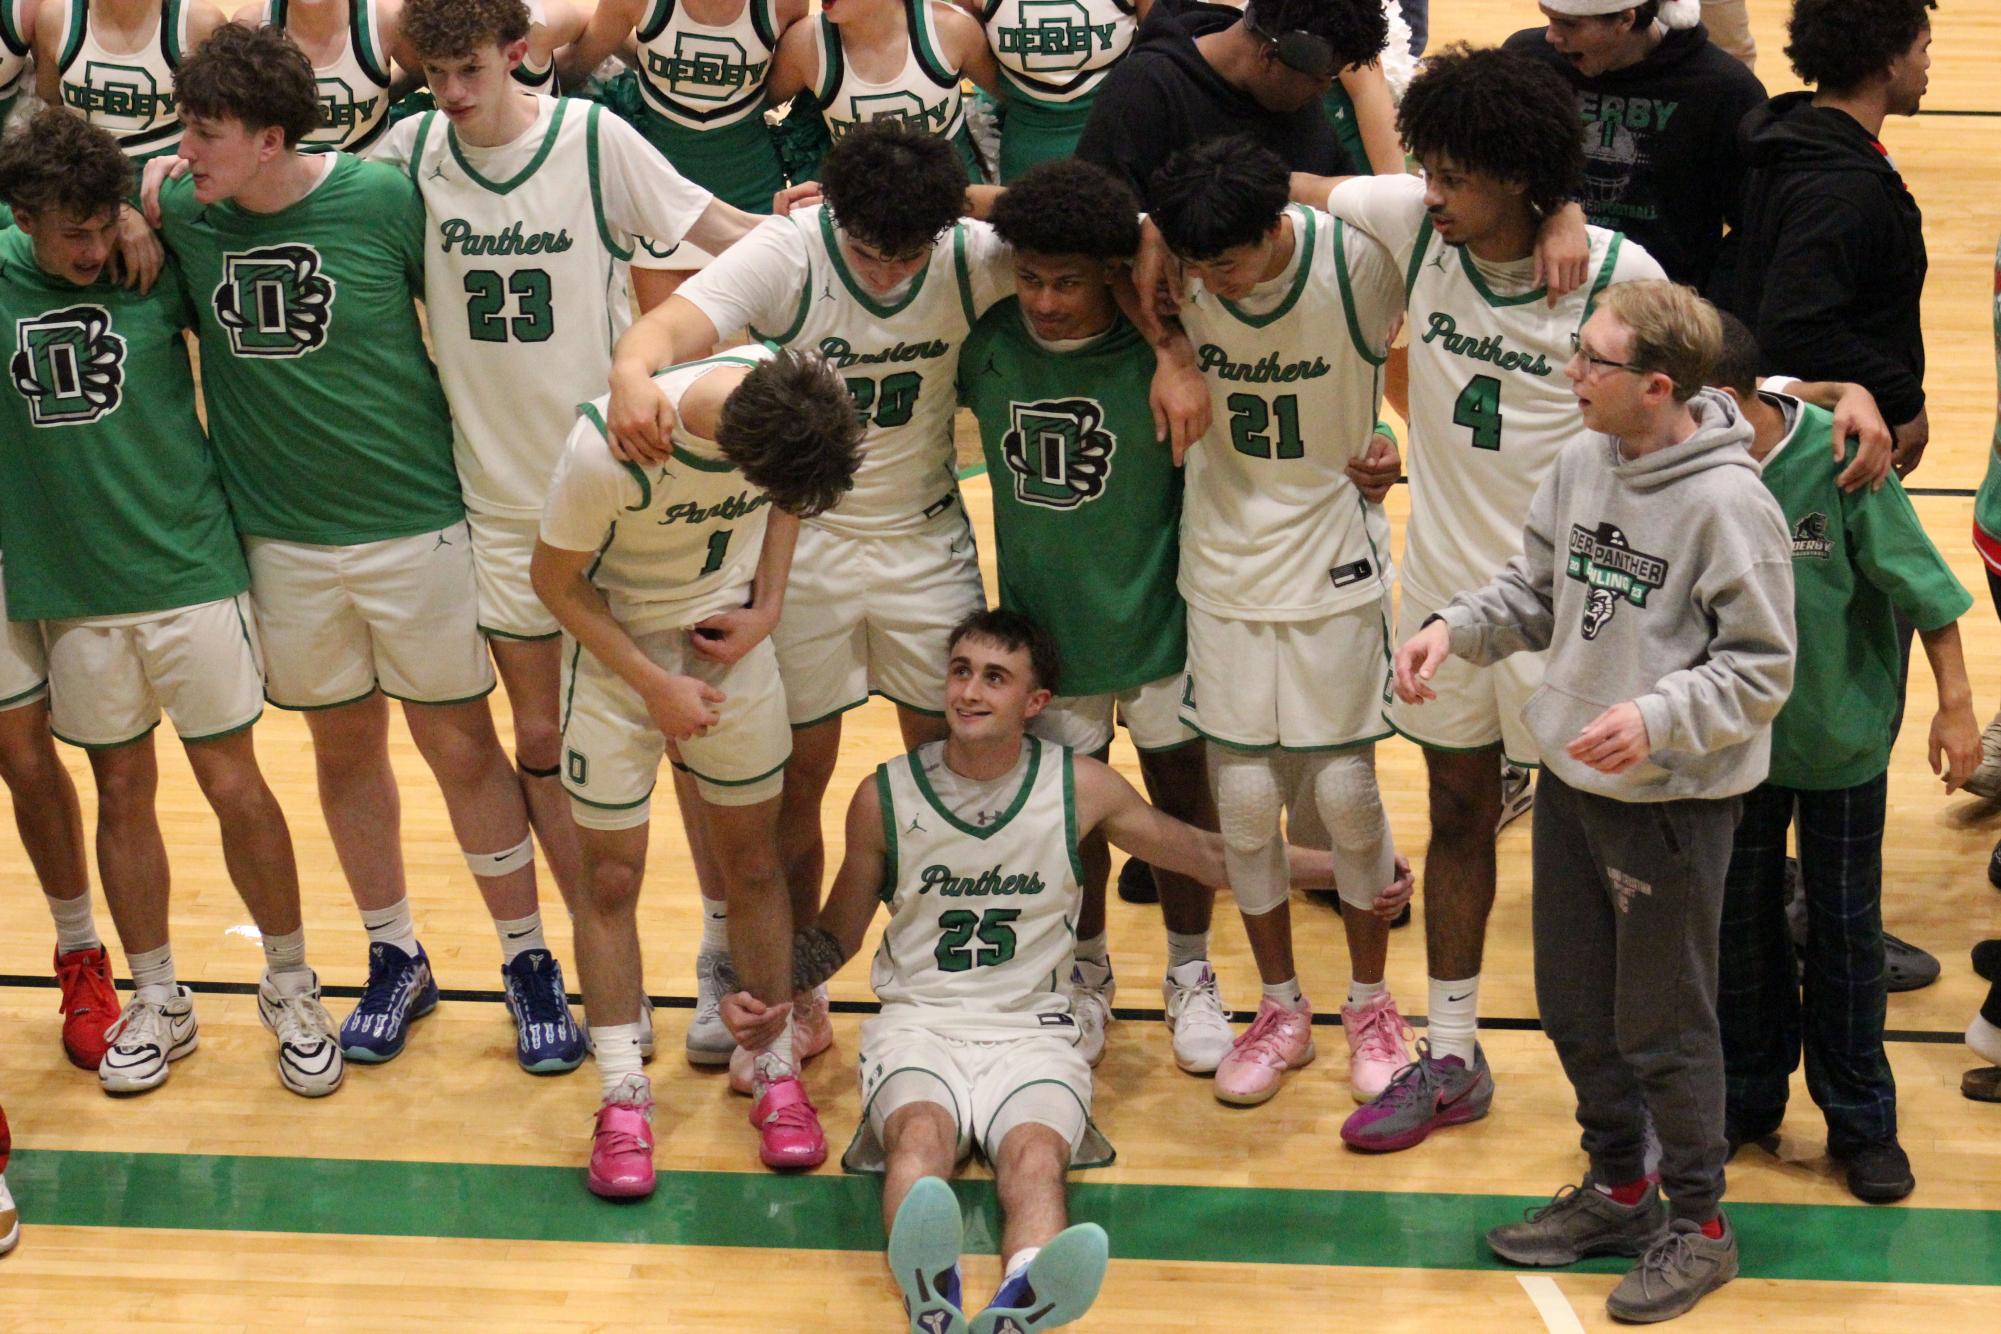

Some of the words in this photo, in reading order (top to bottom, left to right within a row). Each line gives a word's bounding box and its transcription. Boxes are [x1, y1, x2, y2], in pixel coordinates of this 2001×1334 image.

[998, 22, 1116, 54] DERBY
[648, 49, 768, 87] DERBY
[64, 80, 177, 118] DERBY
[1578, 90, 1679, 131] ERBY
[440, 218, 573, 255] Panthers
[463, 268, 554, 342] 23
[1197, 344, 1331, 383] Panthers
[1421, 312, 1552, 376] Panthers
[1227, 392, 1304, 459] 21
[1453, 374, 1502, 451] 4
[657, 490, 773, 525] Panthe
[699, 528, 734, 577] 1
[1594, 546, 1662, 583] PANTHER
[918, 864, 1046, 897] Panthers
[934, 908, 1022, 972] 25
